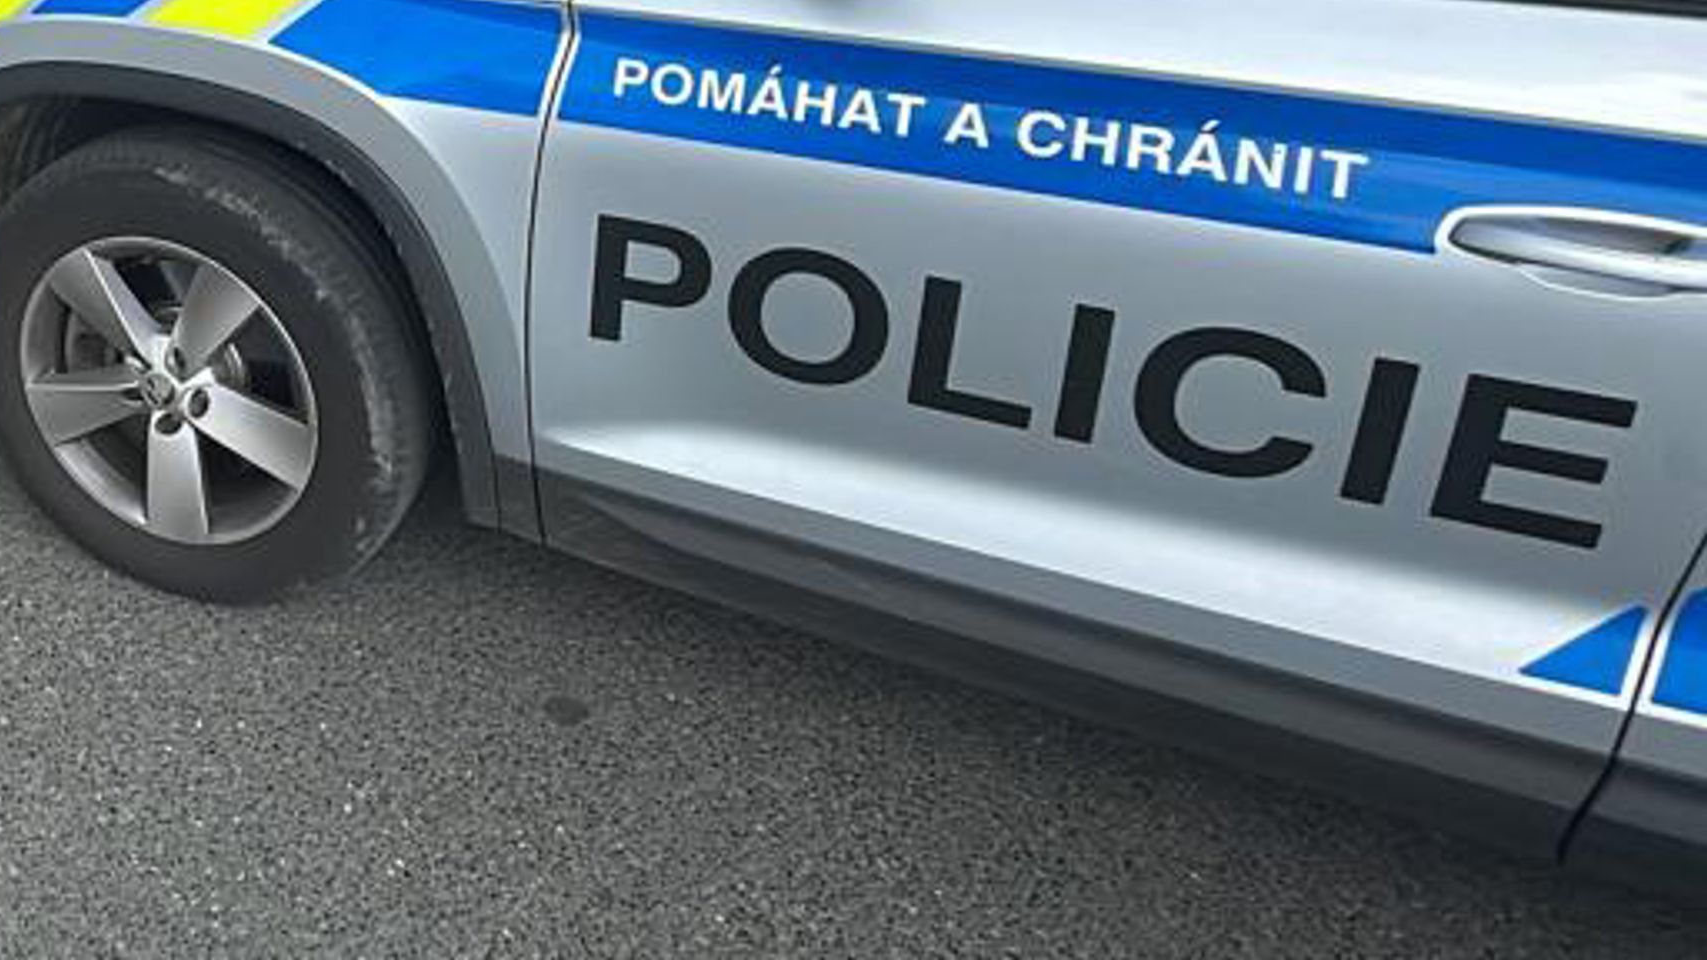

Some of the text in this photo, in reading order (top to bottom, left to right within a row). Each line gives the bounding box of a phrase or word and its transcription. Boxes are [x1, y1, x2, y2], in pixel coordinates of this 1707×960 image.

[613, 56, 1370, 200] POMÁHAT A CHRÁNIT
[587, 212, 1639, 551] POLICIE
